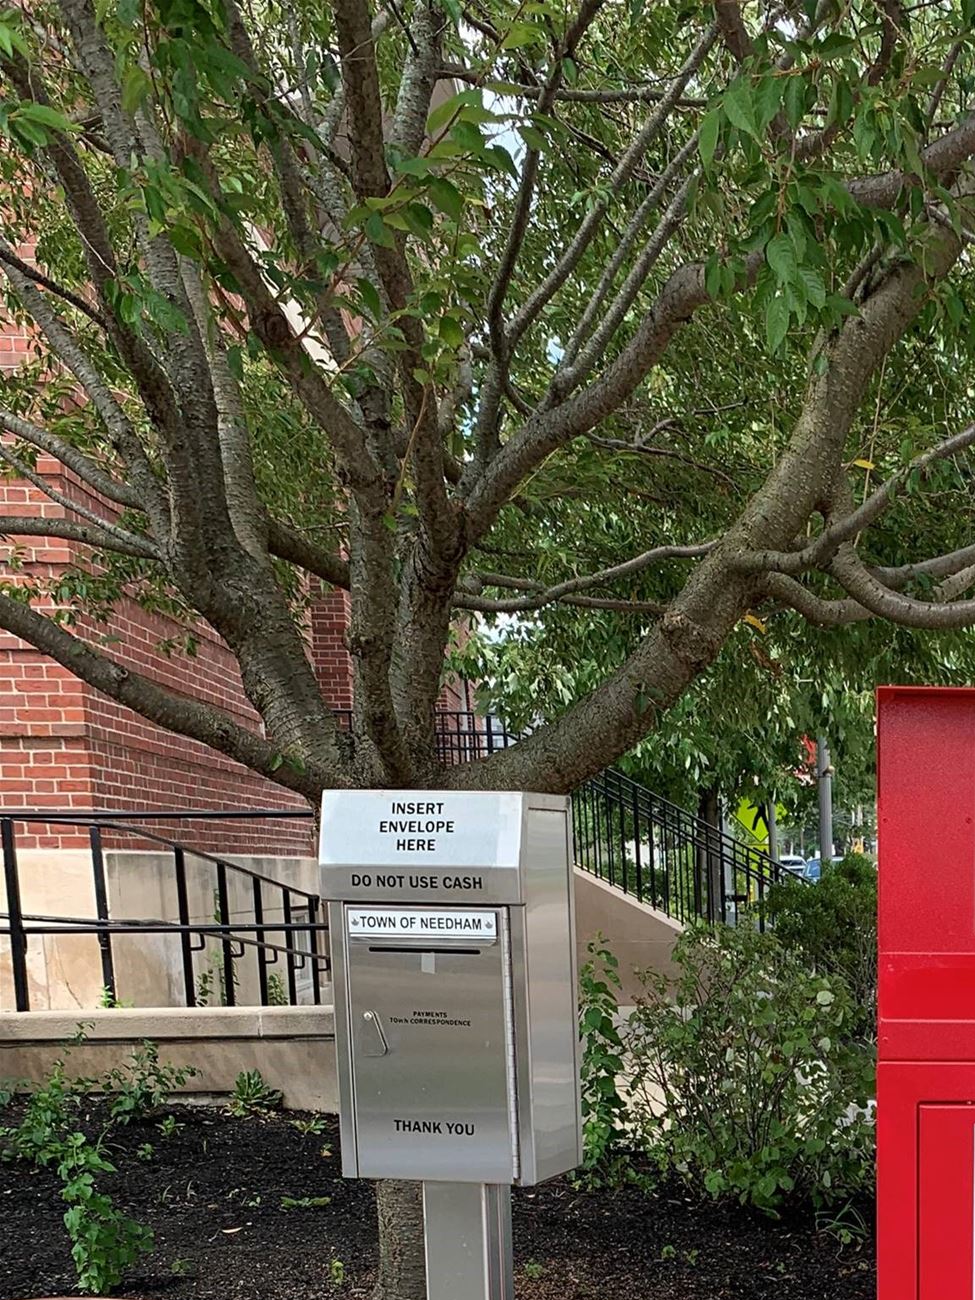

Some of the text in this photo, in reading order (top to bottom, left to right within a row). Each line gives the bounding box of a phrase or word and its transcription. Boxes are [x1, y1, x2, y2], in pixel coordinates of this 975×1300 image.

[392, 802, 444, 814] INSERT
[379, 820, 454, 833] ENVELOPE
[396, 839, 436, 851] HERE
[351, 874, 482, 889] DO NOT USE CASH
[360, 916, 482, 930] TOWN OF NEEDHAM
[410, 1018, 471, 1027] CORRESPONDENCE
[394, 1120, 475, 1136] THANK YOU
